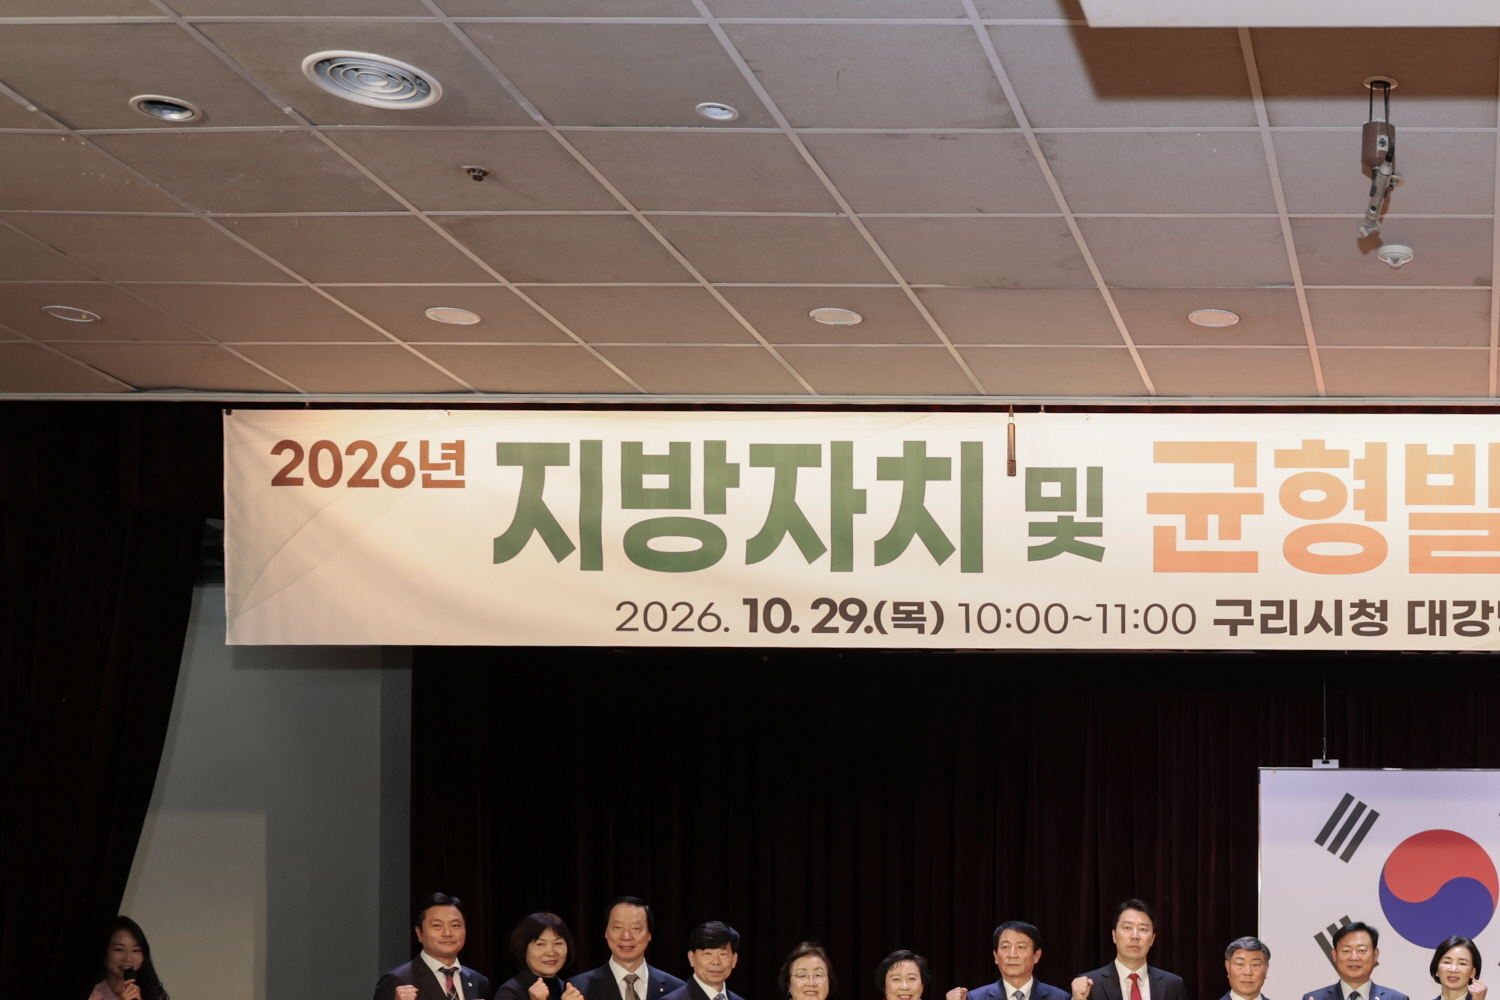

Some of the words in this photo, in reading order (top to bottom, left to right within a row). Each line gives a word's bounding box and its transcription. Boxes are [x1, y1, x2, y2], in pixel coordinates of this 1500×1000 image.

[270, 439, 466, 489] 2026년
[493, 439, 984, 574] 지방자치
[1025, 466, 1106, 563] 및
[615, 600, 730, 633] 2026.
[742, 597, 800, 634] 10.
[811, 597, 945, 635] 29.(목)
[958, 602, 1197, 635] 10:00~11:00
[1212, 598, 1390, 637] 구리시청
